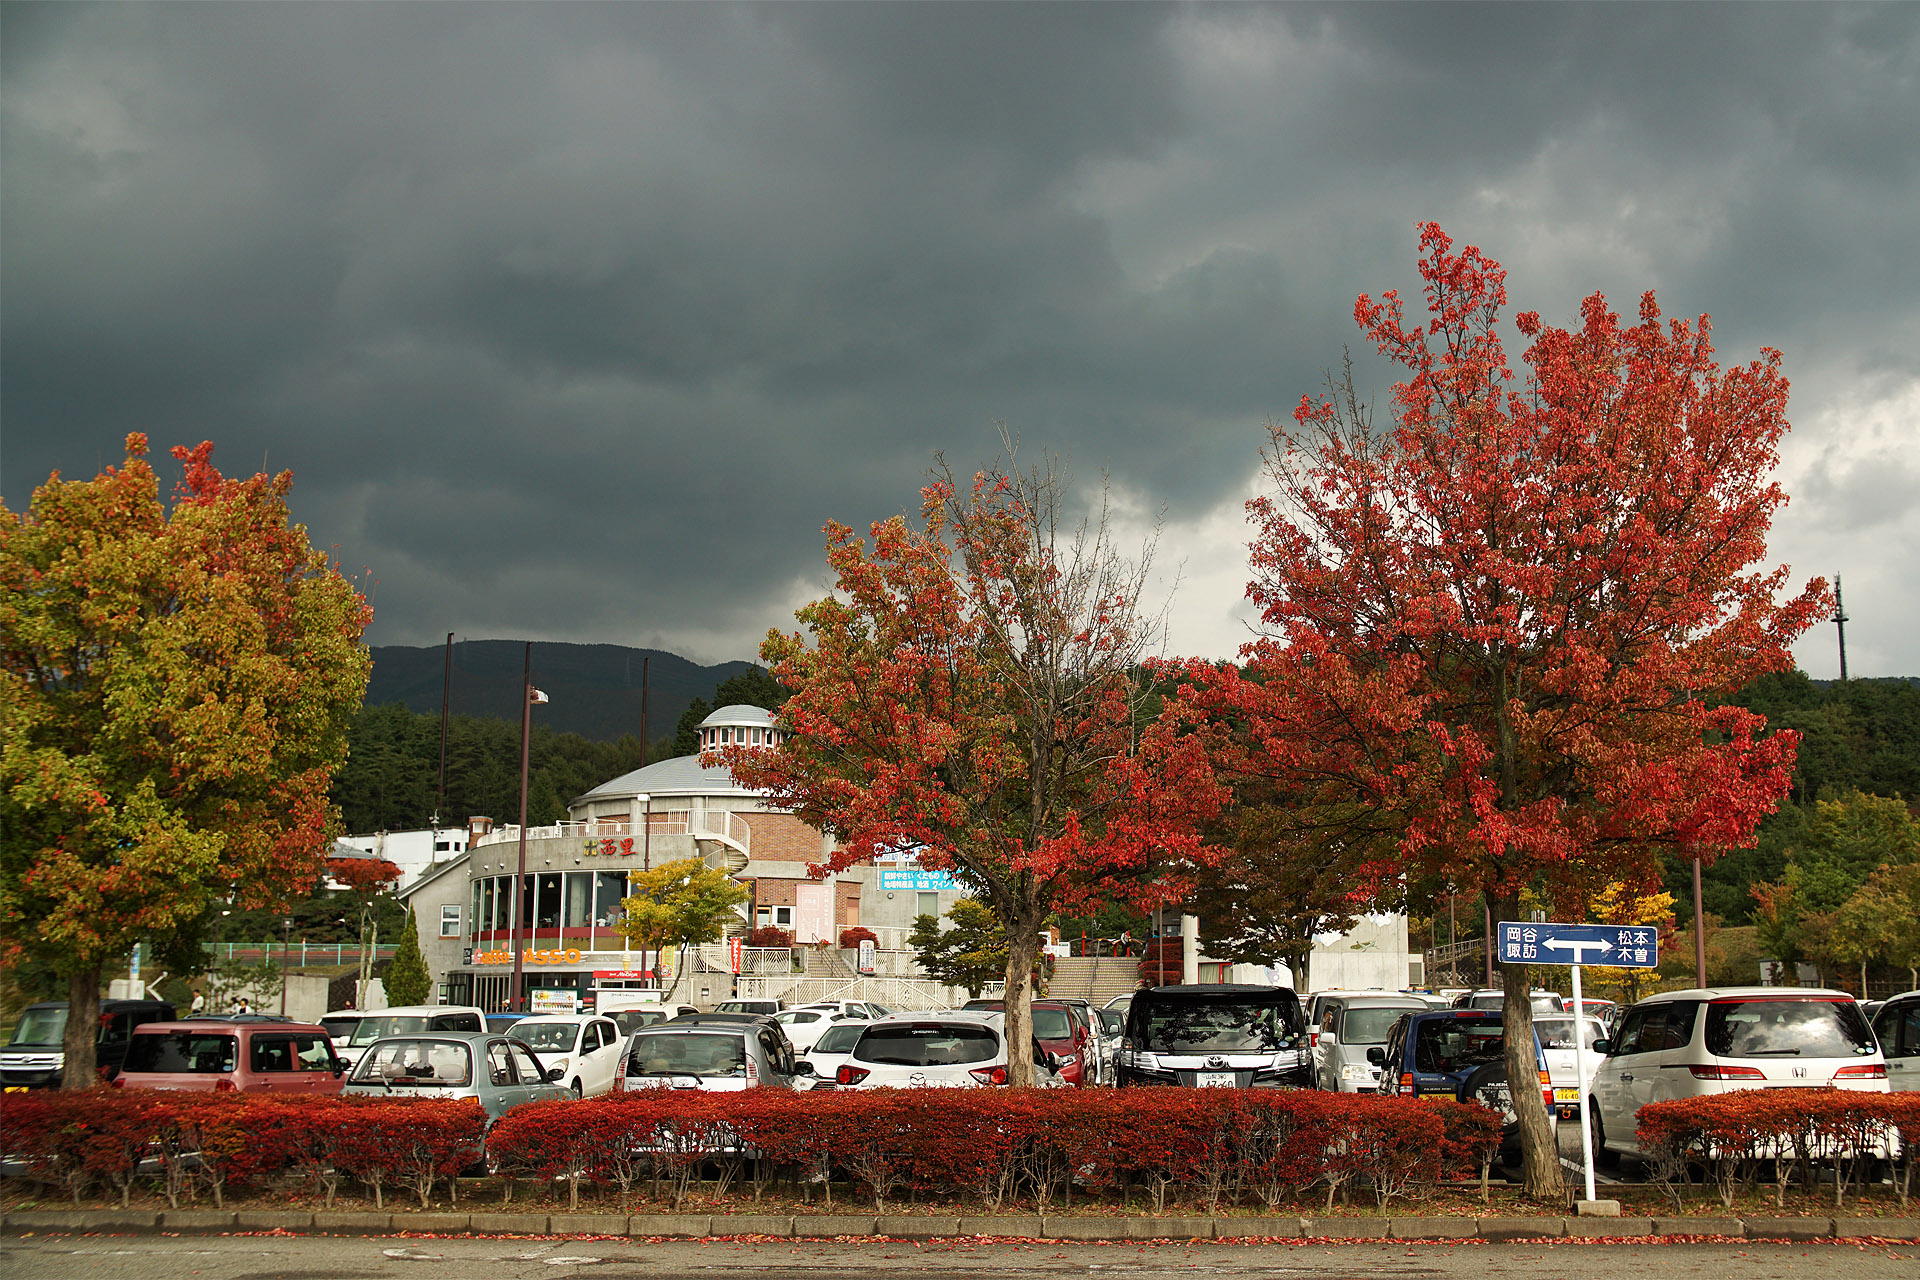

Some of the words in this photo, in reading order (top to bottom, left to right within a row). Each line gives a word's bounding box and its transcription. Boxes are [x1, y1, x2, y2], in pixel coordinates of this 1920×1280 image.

[884, 872, 914, 880] 新鮮やさい
[917, 872, 940, 880] くだもの
[932, 881, 950, 889] ワイン
[1507, 927, 1538, 943] 岡谷
[1618, 930, 1649, 946] 松本
[521, 948, 581, 965] ASSO
[1507, 943, 1537, 959] 諏訪
[1618, 947, 1648, 963] 木曽
